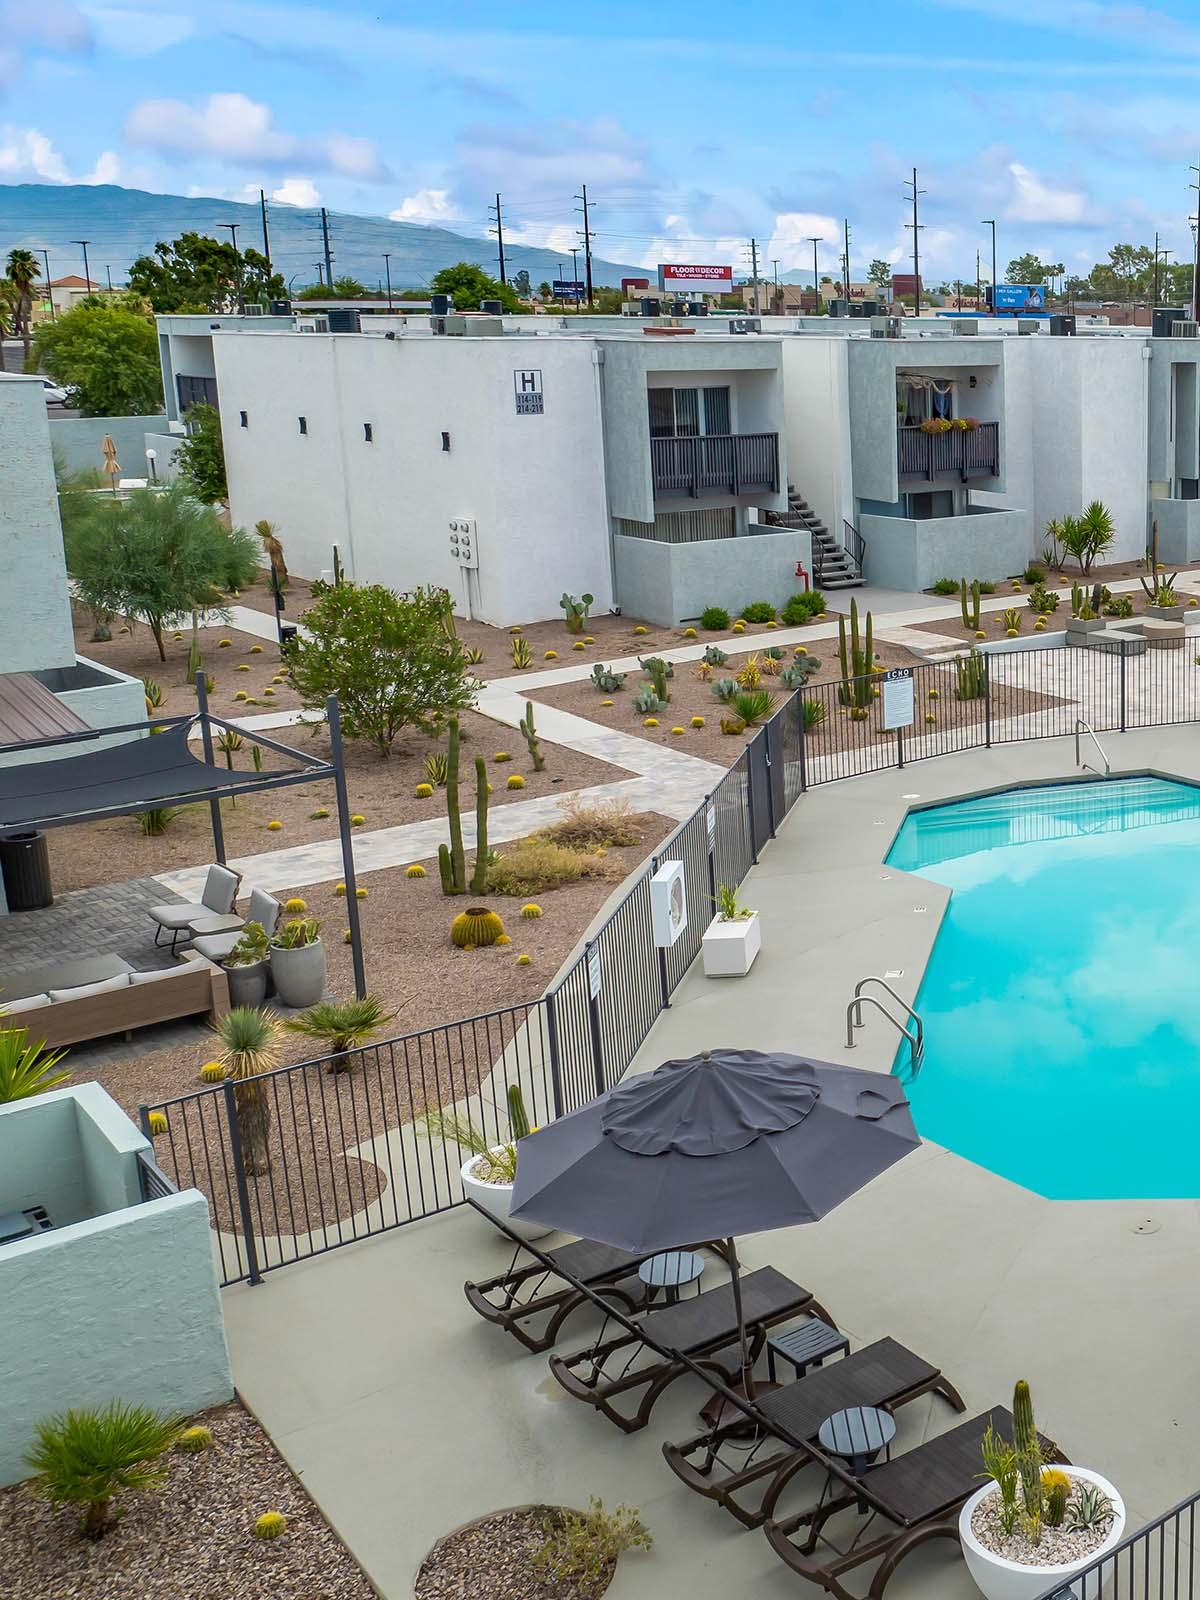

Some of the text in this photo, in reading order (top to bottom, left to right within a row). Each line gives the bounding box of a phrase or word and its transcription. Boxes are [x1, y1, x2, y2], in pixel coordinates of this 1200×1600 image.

[700, 267, 724, 275] DECOR
[521, 372, 535, 392] H
[517, 395, 542, 404] 114-119
[517, 404, 543, 413] 214-219
[887, 669, 910, 679] ECHO
